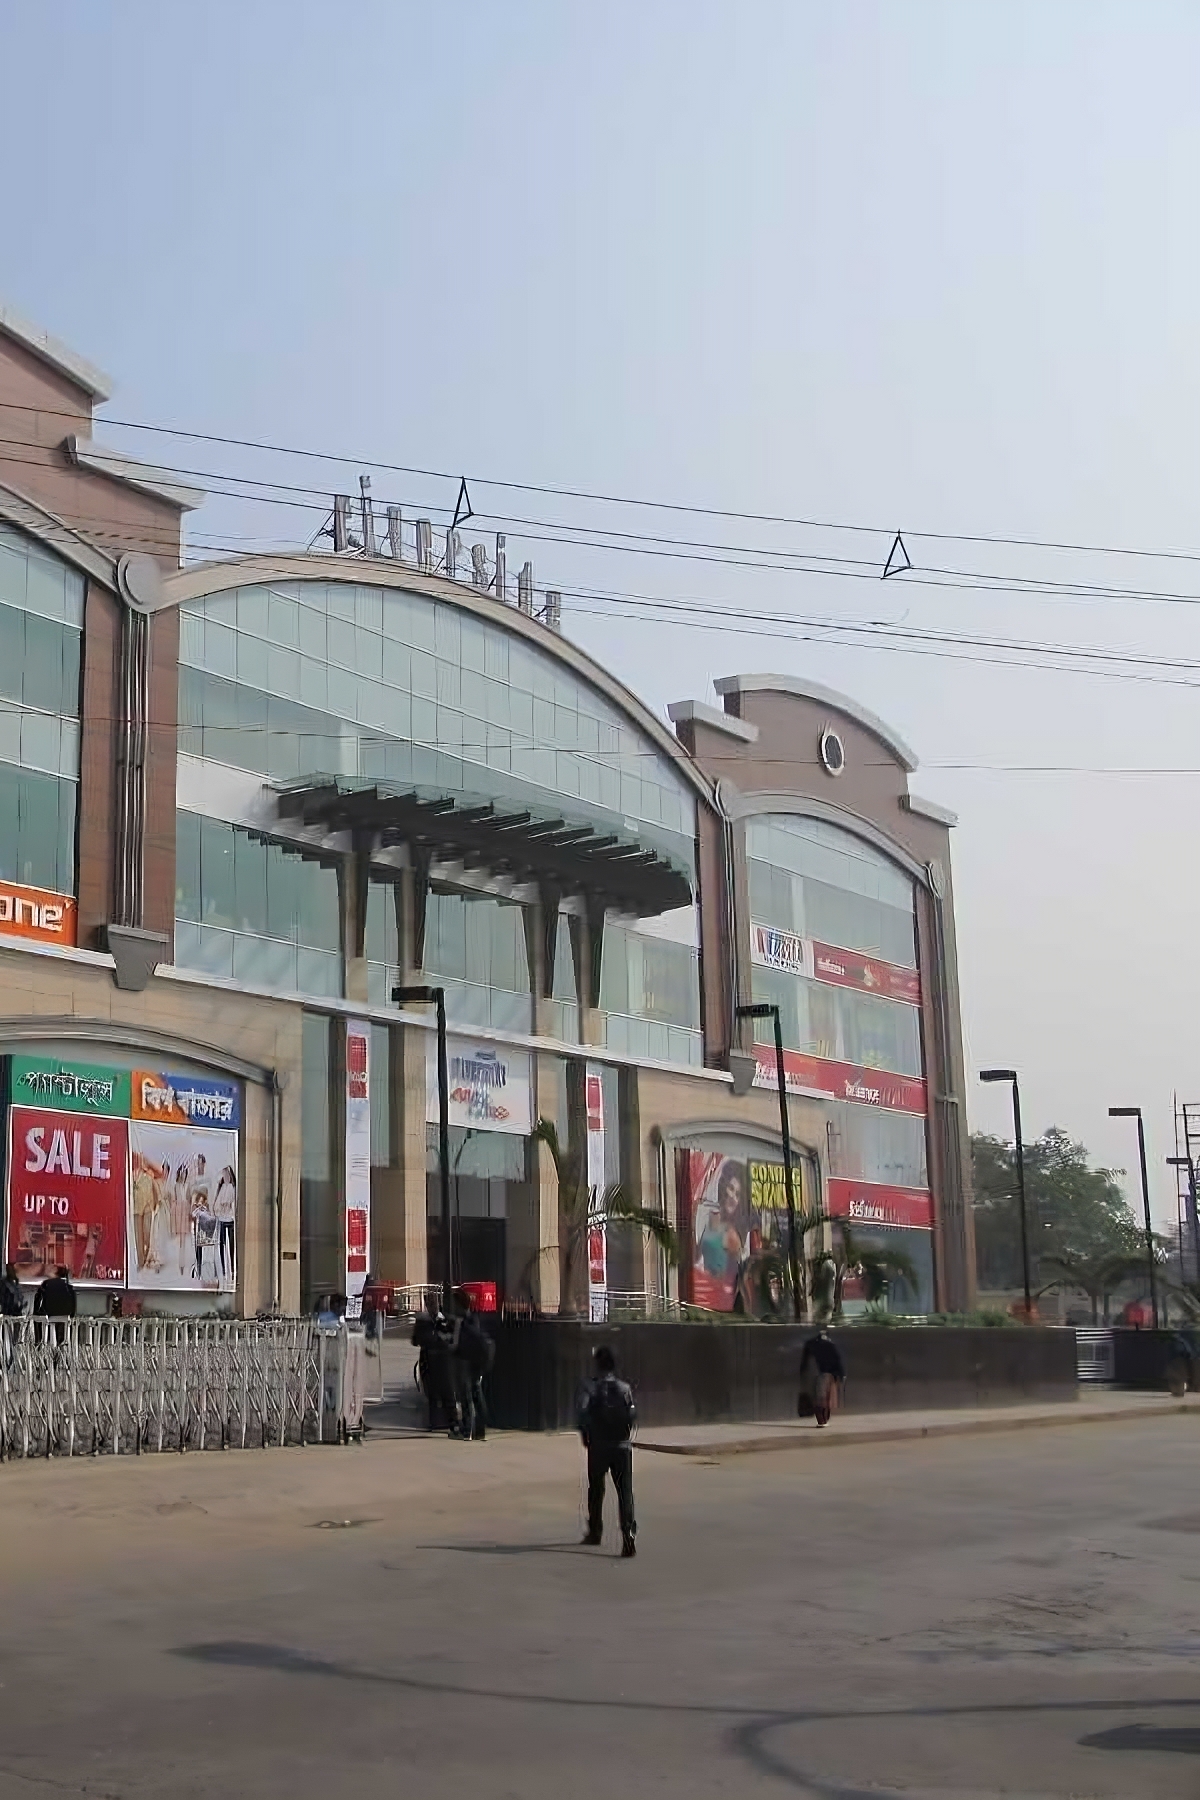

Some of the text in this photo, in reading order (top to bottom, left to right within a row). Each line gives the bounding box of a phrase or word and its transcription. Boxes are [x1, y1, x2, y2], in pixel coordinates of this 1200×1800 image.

[25, 1127, 111, 1179] SALE
[25, 1193, 69, 1216] UP TO
